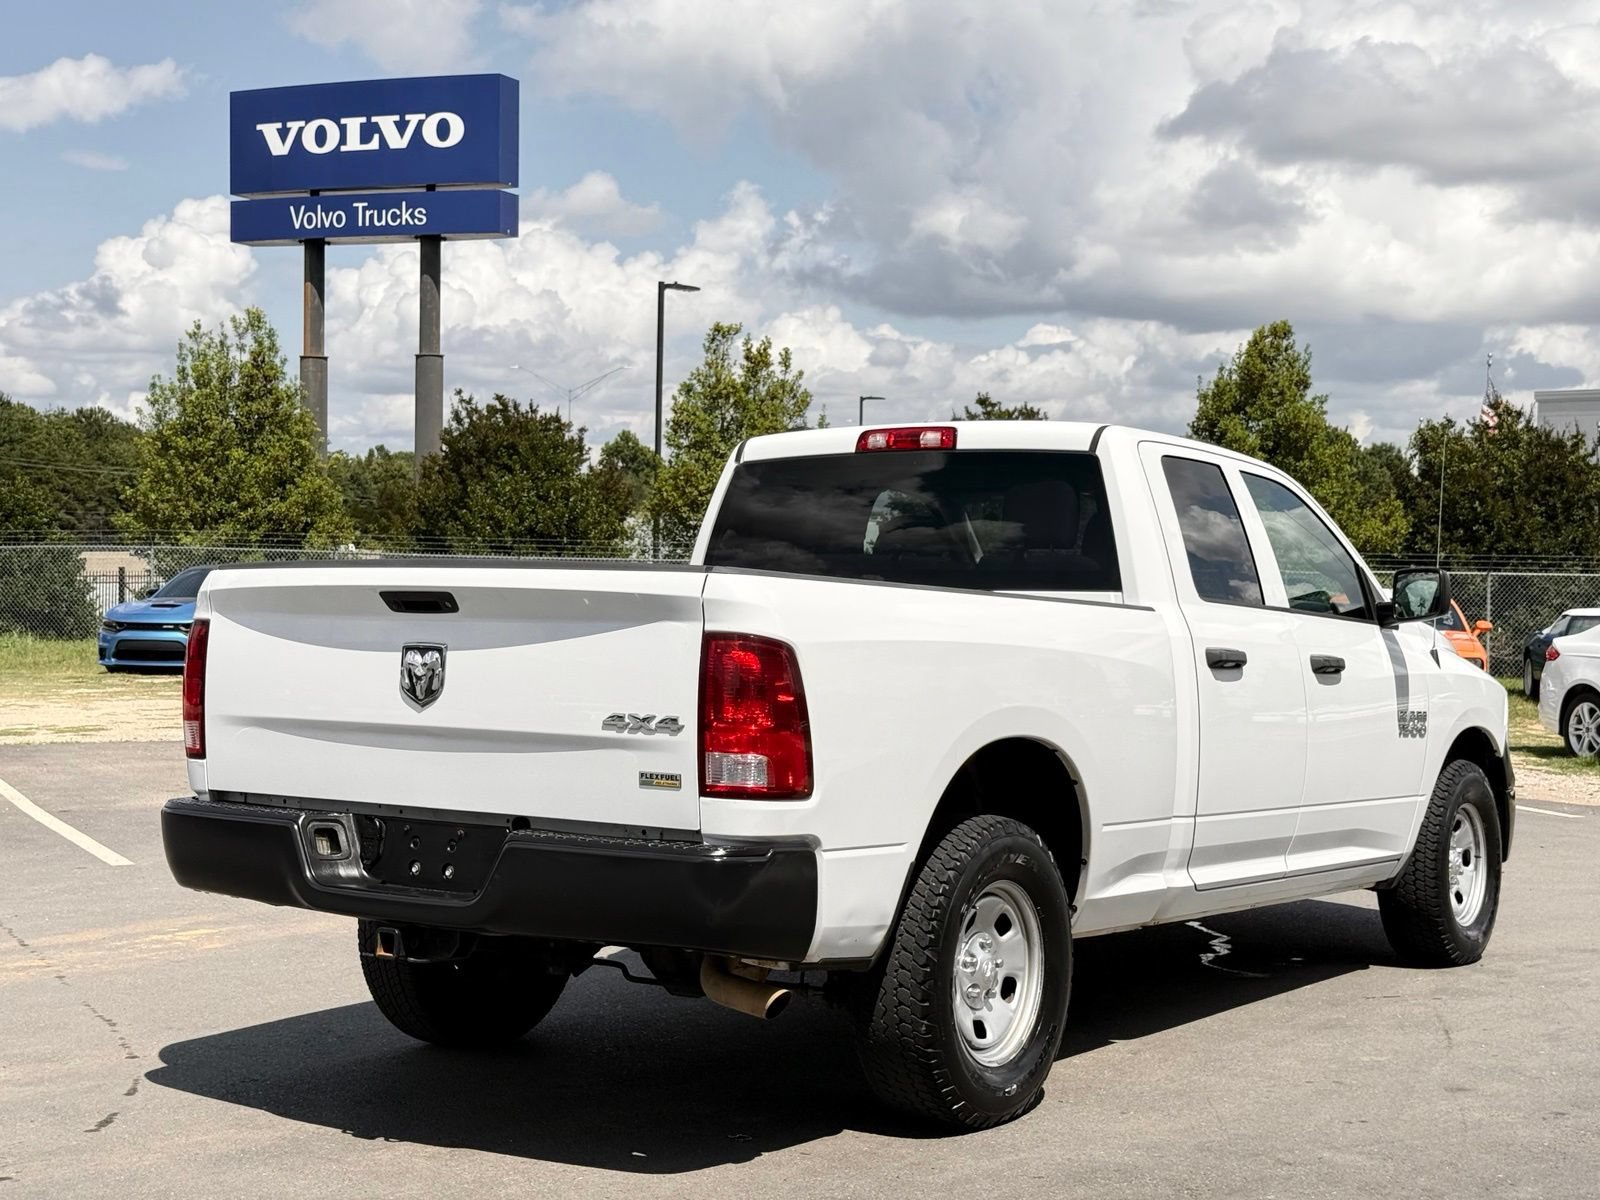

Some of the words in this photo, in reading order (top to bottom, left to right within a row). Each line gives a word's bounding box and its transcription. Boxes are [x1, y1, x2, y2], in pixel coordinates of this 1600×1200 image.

[256, 111, 465, 156] VOLVO
[289, 204, 346, 230] Volvo
[352, 201, 427, 227] Trucks
